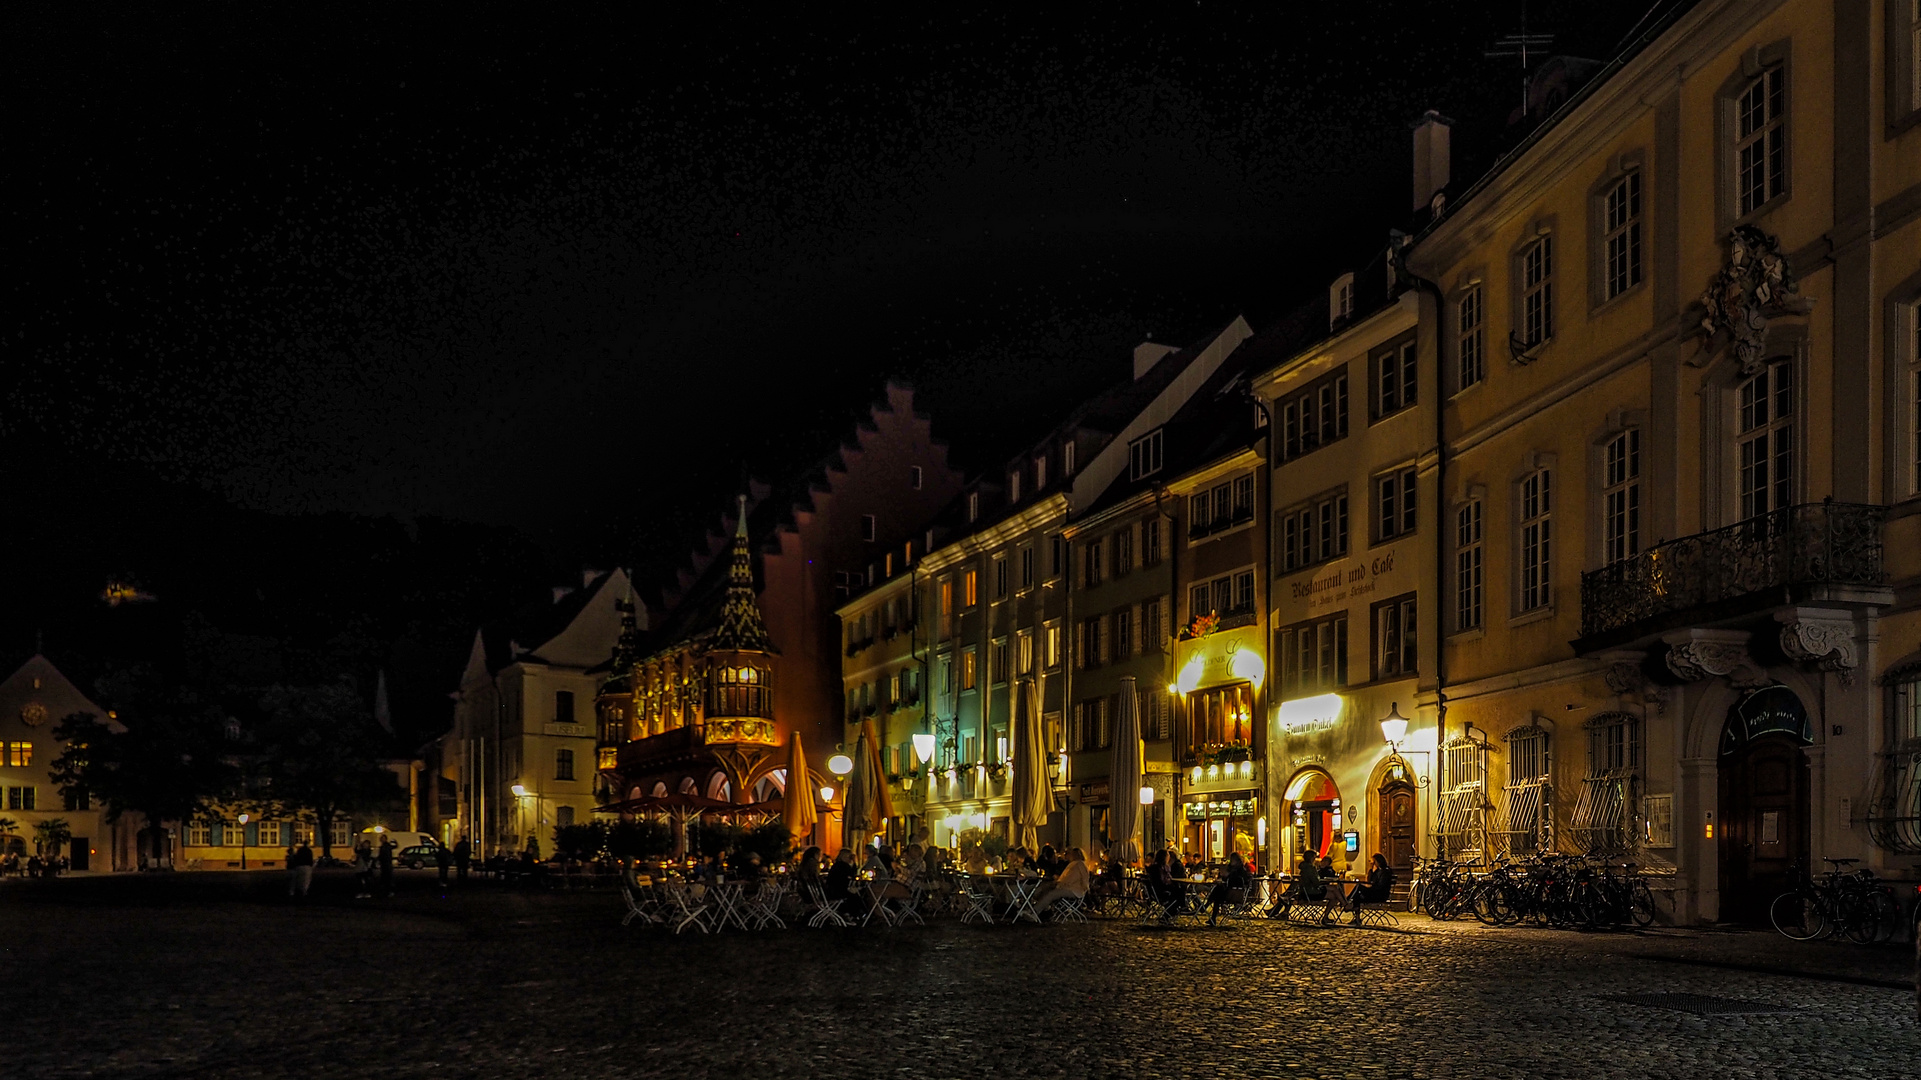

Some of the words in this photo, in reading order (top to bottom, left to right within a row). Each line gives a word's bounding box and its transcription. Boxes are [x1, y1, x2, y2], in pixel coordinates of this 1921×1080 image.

[1291, 568, 1342, 599] Restaurant
[1348, 563, 1366, 583] und
[1371, 550, 1396, 576] Café
[1832, 724, 1842, 736] 10
